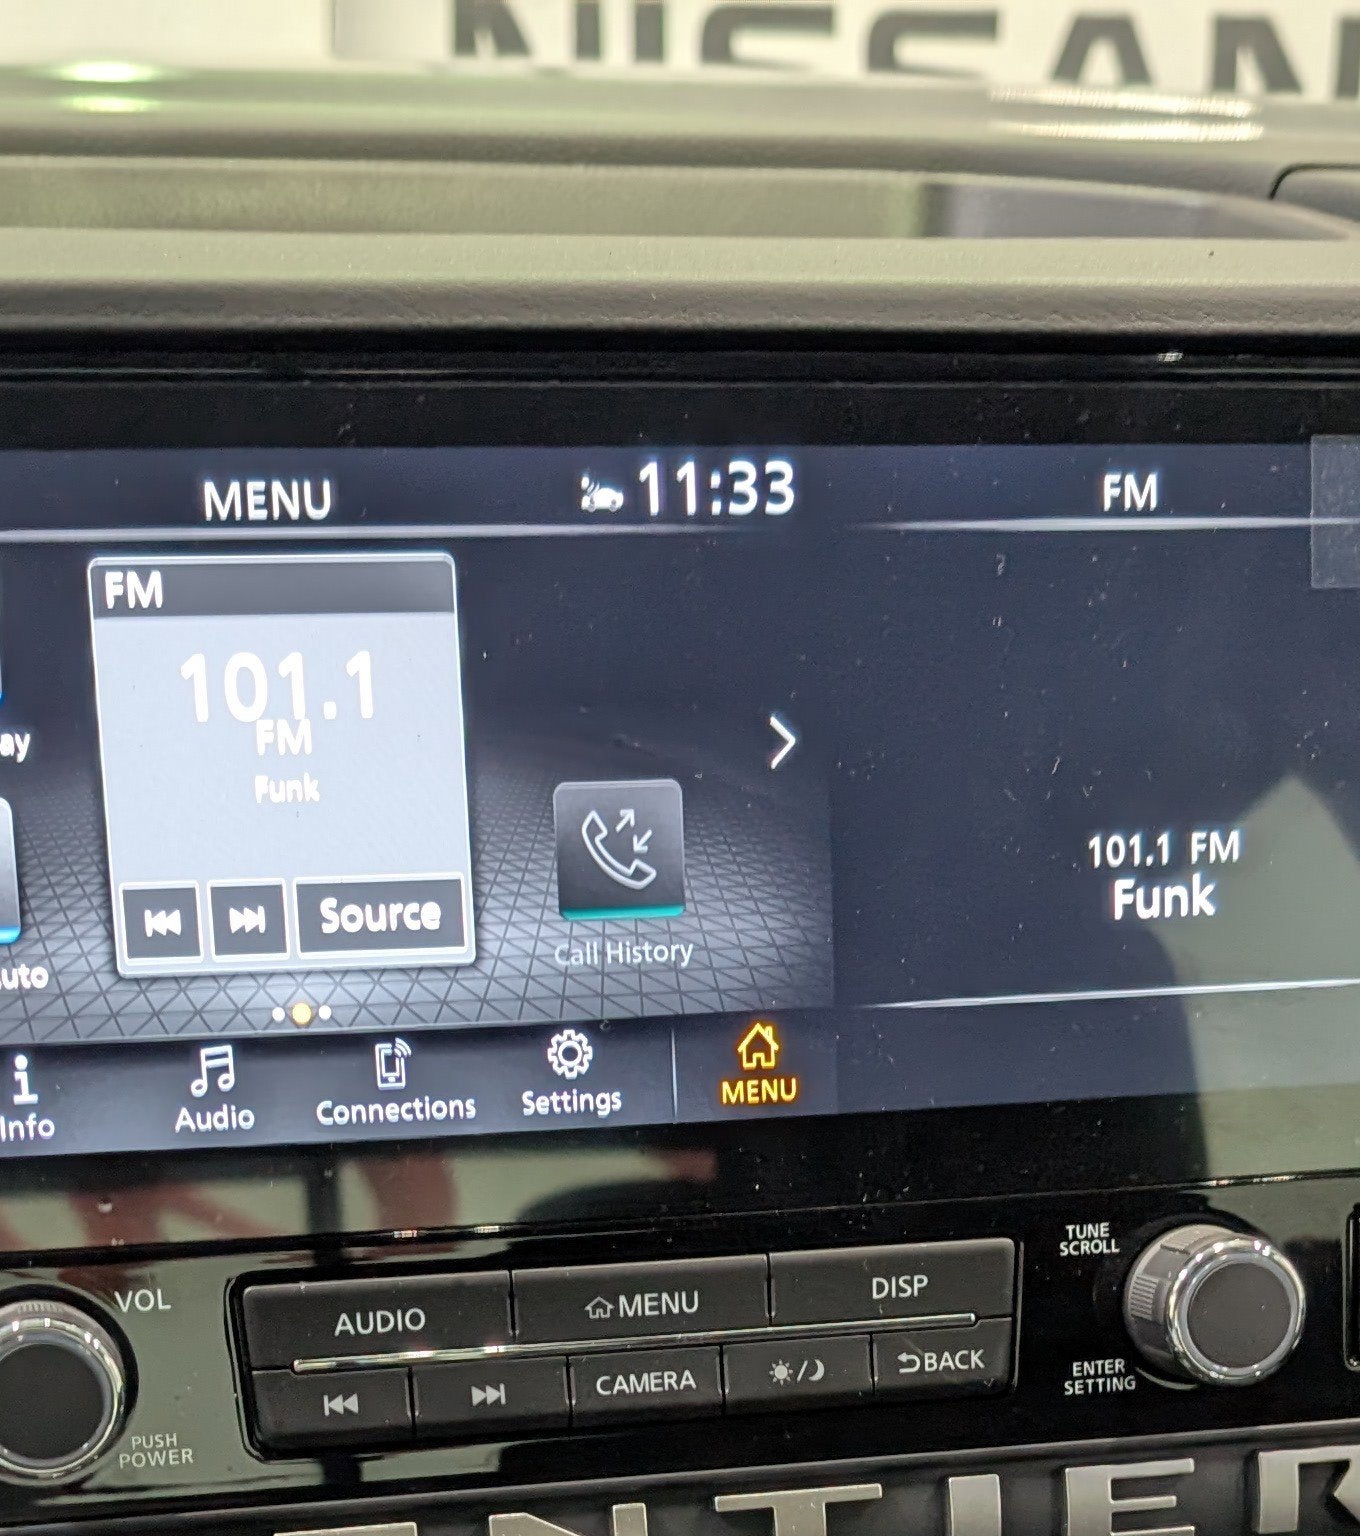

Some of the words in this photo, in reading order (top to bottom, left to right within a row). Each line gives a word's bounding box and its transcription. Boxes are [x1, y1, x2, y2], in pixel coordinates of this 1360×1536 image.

[204, 479, 333, 521] MENU
[638, 460, 796, 518] 11:33
[1102, 473, 1159, 514] FM
[104, 571, 164, 608] FM
[180, 651, 375, 723] 101.1
[255, 718, 312, 756] FM
[254, 775, 321, 804] Funk
[1087, 832, 1171, 869] 101.1
[1190, 830, 1241, 865] FM
[1112, 875, 1217, 922] Funk
[320, 896, 442, 935] Source
[553, 940, 599, 967] Call
[605, 937, 695, 970] History
[521, 1084, 622, 1119] Settings
[721, 1074, 797, 1106] MENU
[174, 1103, 256, 1134] Audio
[315, 1094, 478, 1125] Connections
[1064, 1221, 1111, 1241] TUNE
[1058, 1238, 1121, 1258] SCROLL
[115, 1289, 173, 1314] VOL
[870, 1273, 930, 1302] DISP
[617, 1289, 700, 1320] MENU
[334, 1307, 426, 1337] AUDIO
[923, 1347, 986, 1374] BACK
[1072, 1358, 1126, 1378] ENTER
[594, 1368, 697, 1398] CAMERA
[1064, 1374, 1137, 1396] SETTING
[130, 1432, 178, 1451] PUSH
[118, 1446, 194, 1470] POWER
